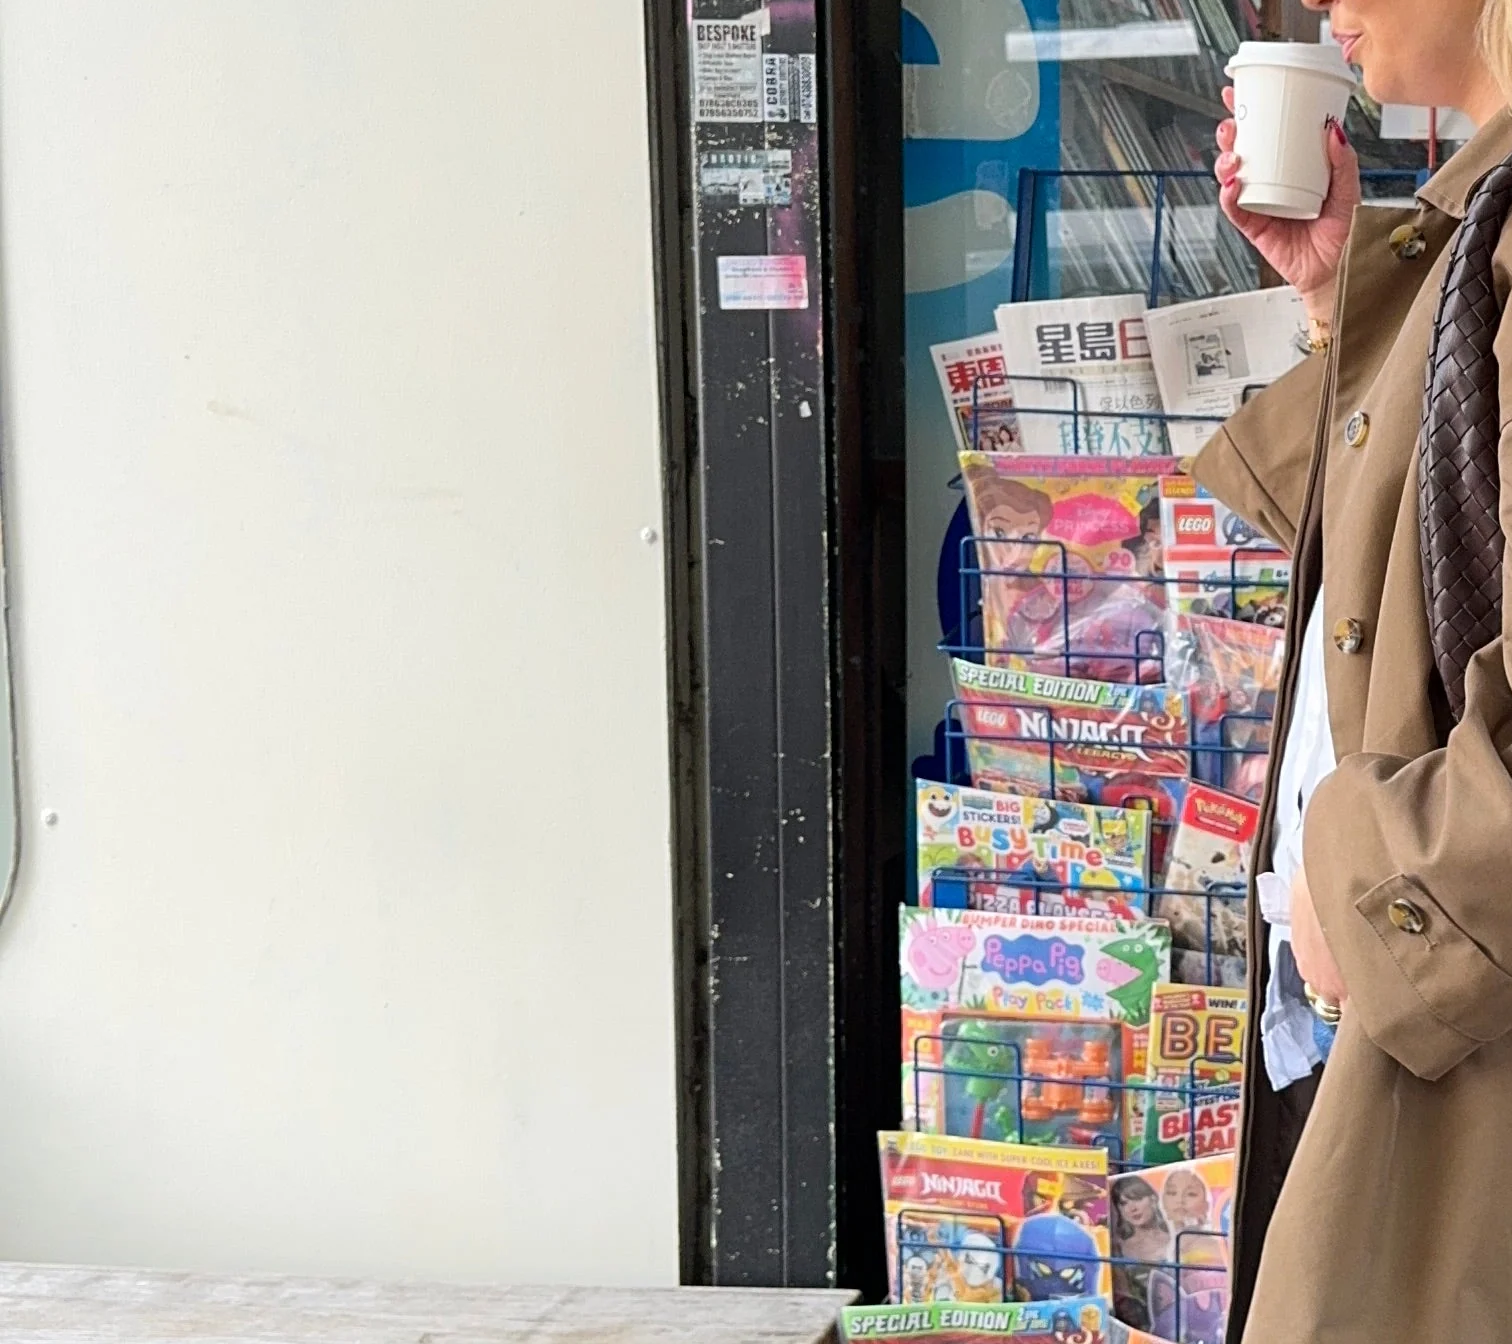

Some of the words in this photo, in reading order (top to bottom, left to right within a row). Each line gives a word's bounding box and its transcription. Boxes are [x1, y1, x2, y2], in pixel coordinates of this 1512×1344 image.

[697, 24, 757, 42] BESPOKE
[765, 57, 778, 105] COBRA
[1053, 517, 1130, 534] PRINCESS
[1177, 515, 1212, 534] LEGO
[1108, 552, 1130, 568] 90
[958, 664, 1027, 695] SPECIAL
[1032, 676, 1102, 704] EDITION
[974, 708, 1007, 728] LEGO
[1016, 708, 1155, 764] NINJAGO
[994, 798, 1021, 814] BIG
[962, 809, 1022, 825] STICKERS!
[962, 914, 1016, 932] BUMPER
[1020, 918, 1056, 933] DINO
[1059, 920, 1116, 935] SPECIAL
[984, 937, 1047, 980] Peppa
[1048, 942, 1083, 981] Pig
[991, 986, 1029, 1014] Play
[1035, 989, 1074, 1014] Pack
[1208, 998, 1237, 1009] WIN!
[919, 1171, 1008, 1206] NINJAGO
[851, 1306, 934, 1336] SPECIAL
[939, 1309, 1011, 1333] EDITION
